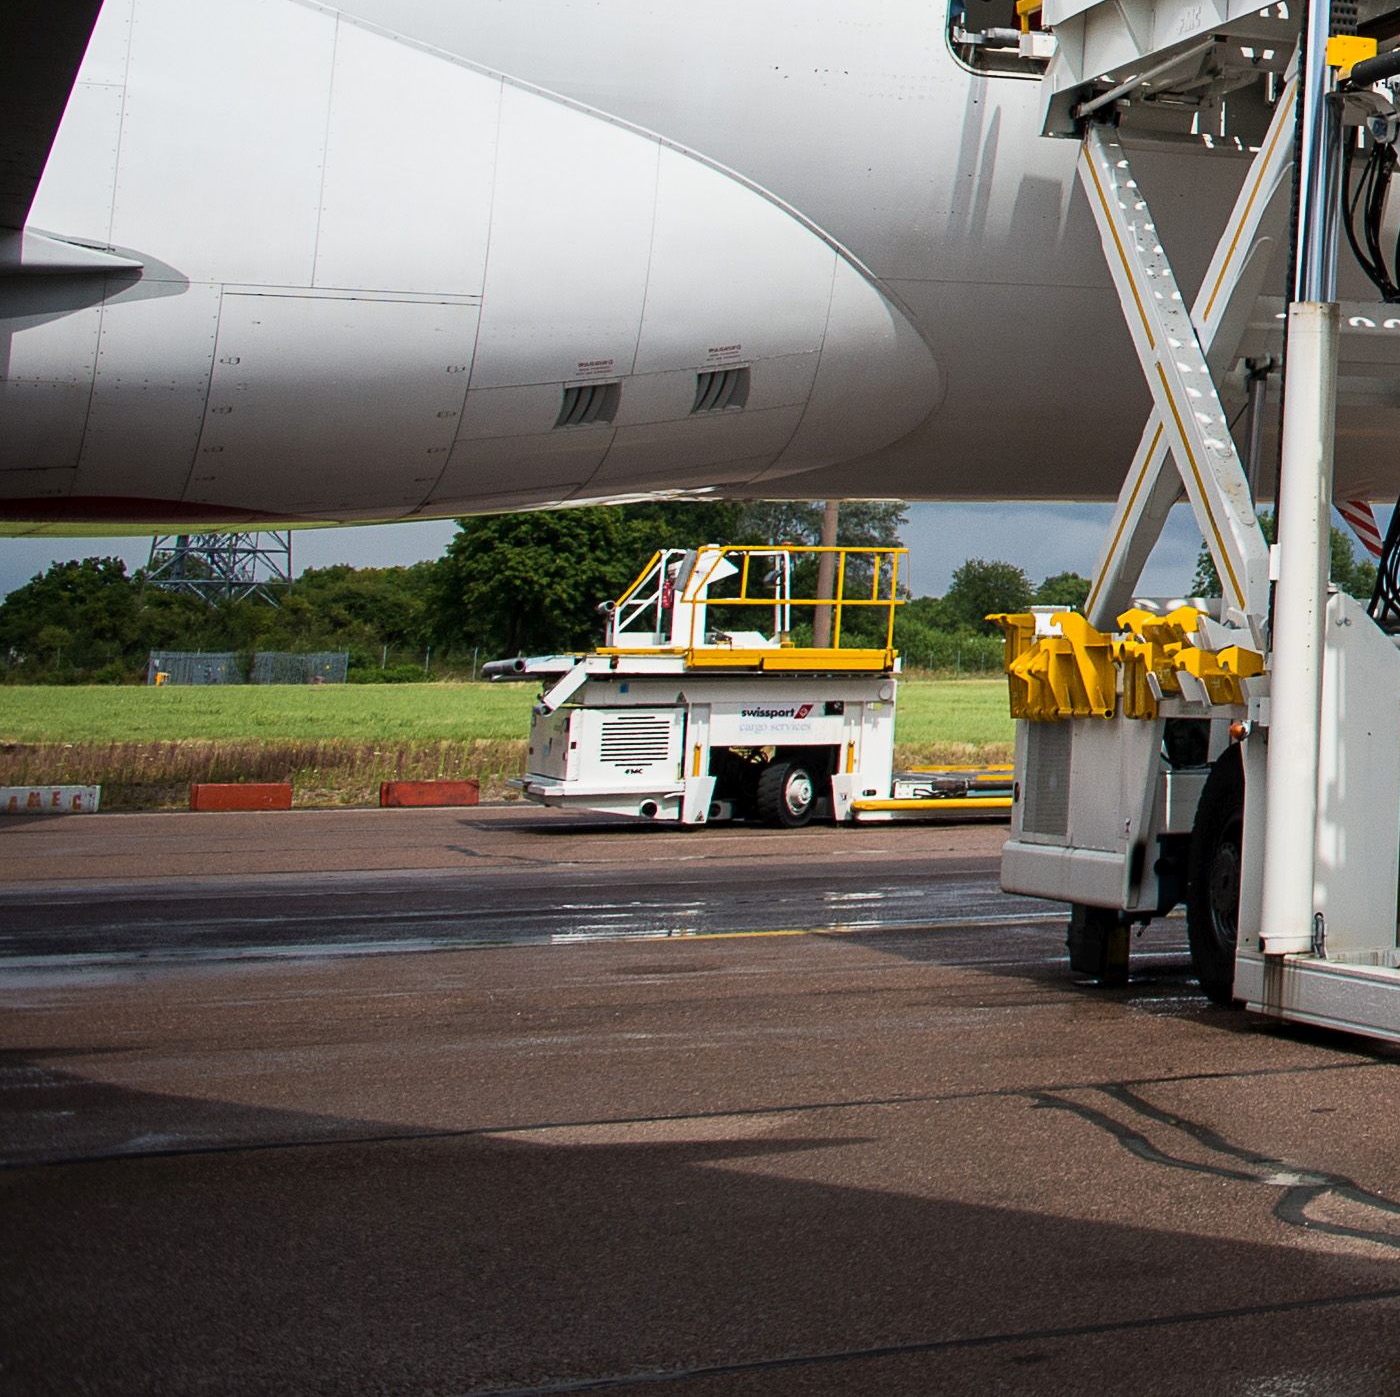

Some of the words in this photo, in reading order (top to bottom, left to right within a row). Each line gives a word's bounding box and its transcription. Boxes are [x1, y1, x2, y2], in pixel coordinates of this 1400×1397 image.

[741, 706, 795, 719] swissport
[740, 723, 767, 734] cargo
[771, 722, 812, 731] services
